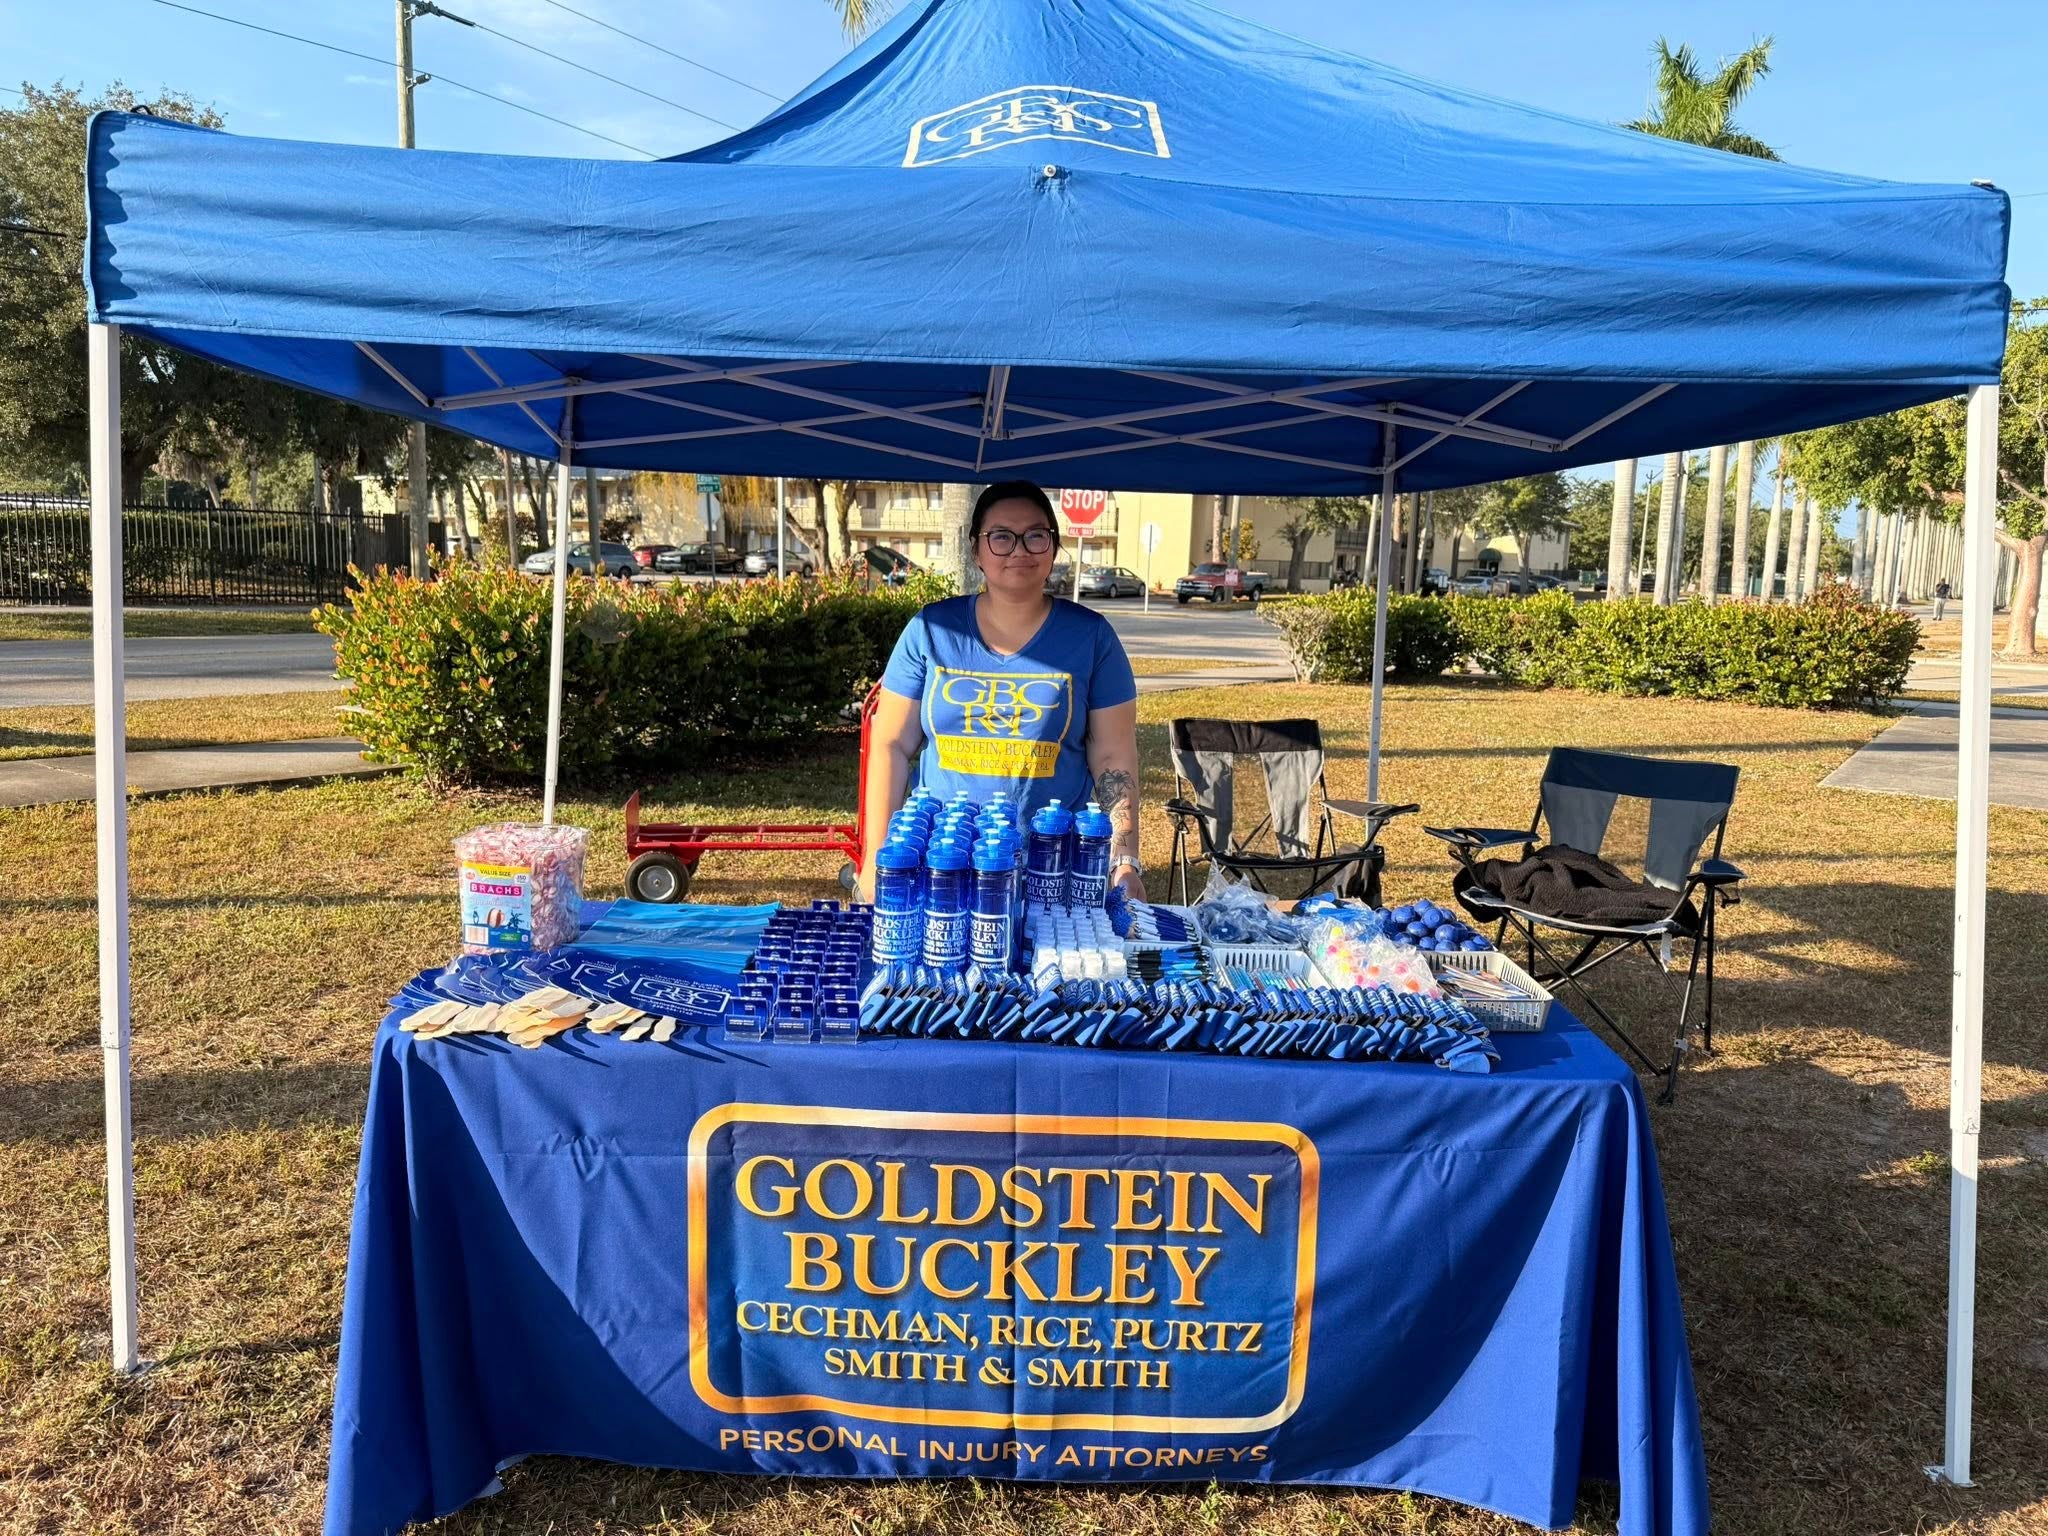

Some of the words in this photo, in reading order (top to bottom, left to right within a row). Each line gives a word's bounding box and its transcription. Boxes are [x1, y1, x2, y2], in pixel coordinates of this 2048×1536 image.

[1063, 489, 1104, 510] STOP
[942, 677, 1060, 708] GBC
[962, 703, 1043, 736] R&P
[735, 1155, 1272, 1234] GOLDSTEIN
[783, 1231, 1221, 1306] BUCKLEY
[736, 1301, 979, 1351] CECHMAN,
[988, 1315, 1102, 1354] RICE,
[1110, 1318, 1264, 1352] PURTZ
[824, 1347, 967, 1382] SMITH
[978, 1356, 1017, 1385] &
[1027, 1358, 1170, 1388] SMITH
[719, 1425, 907, 1456] PERSONAL
[919, 1439, 1047, 1463] INJURY
[1055, 1445, 1270, 1467] ATTORNEYS
